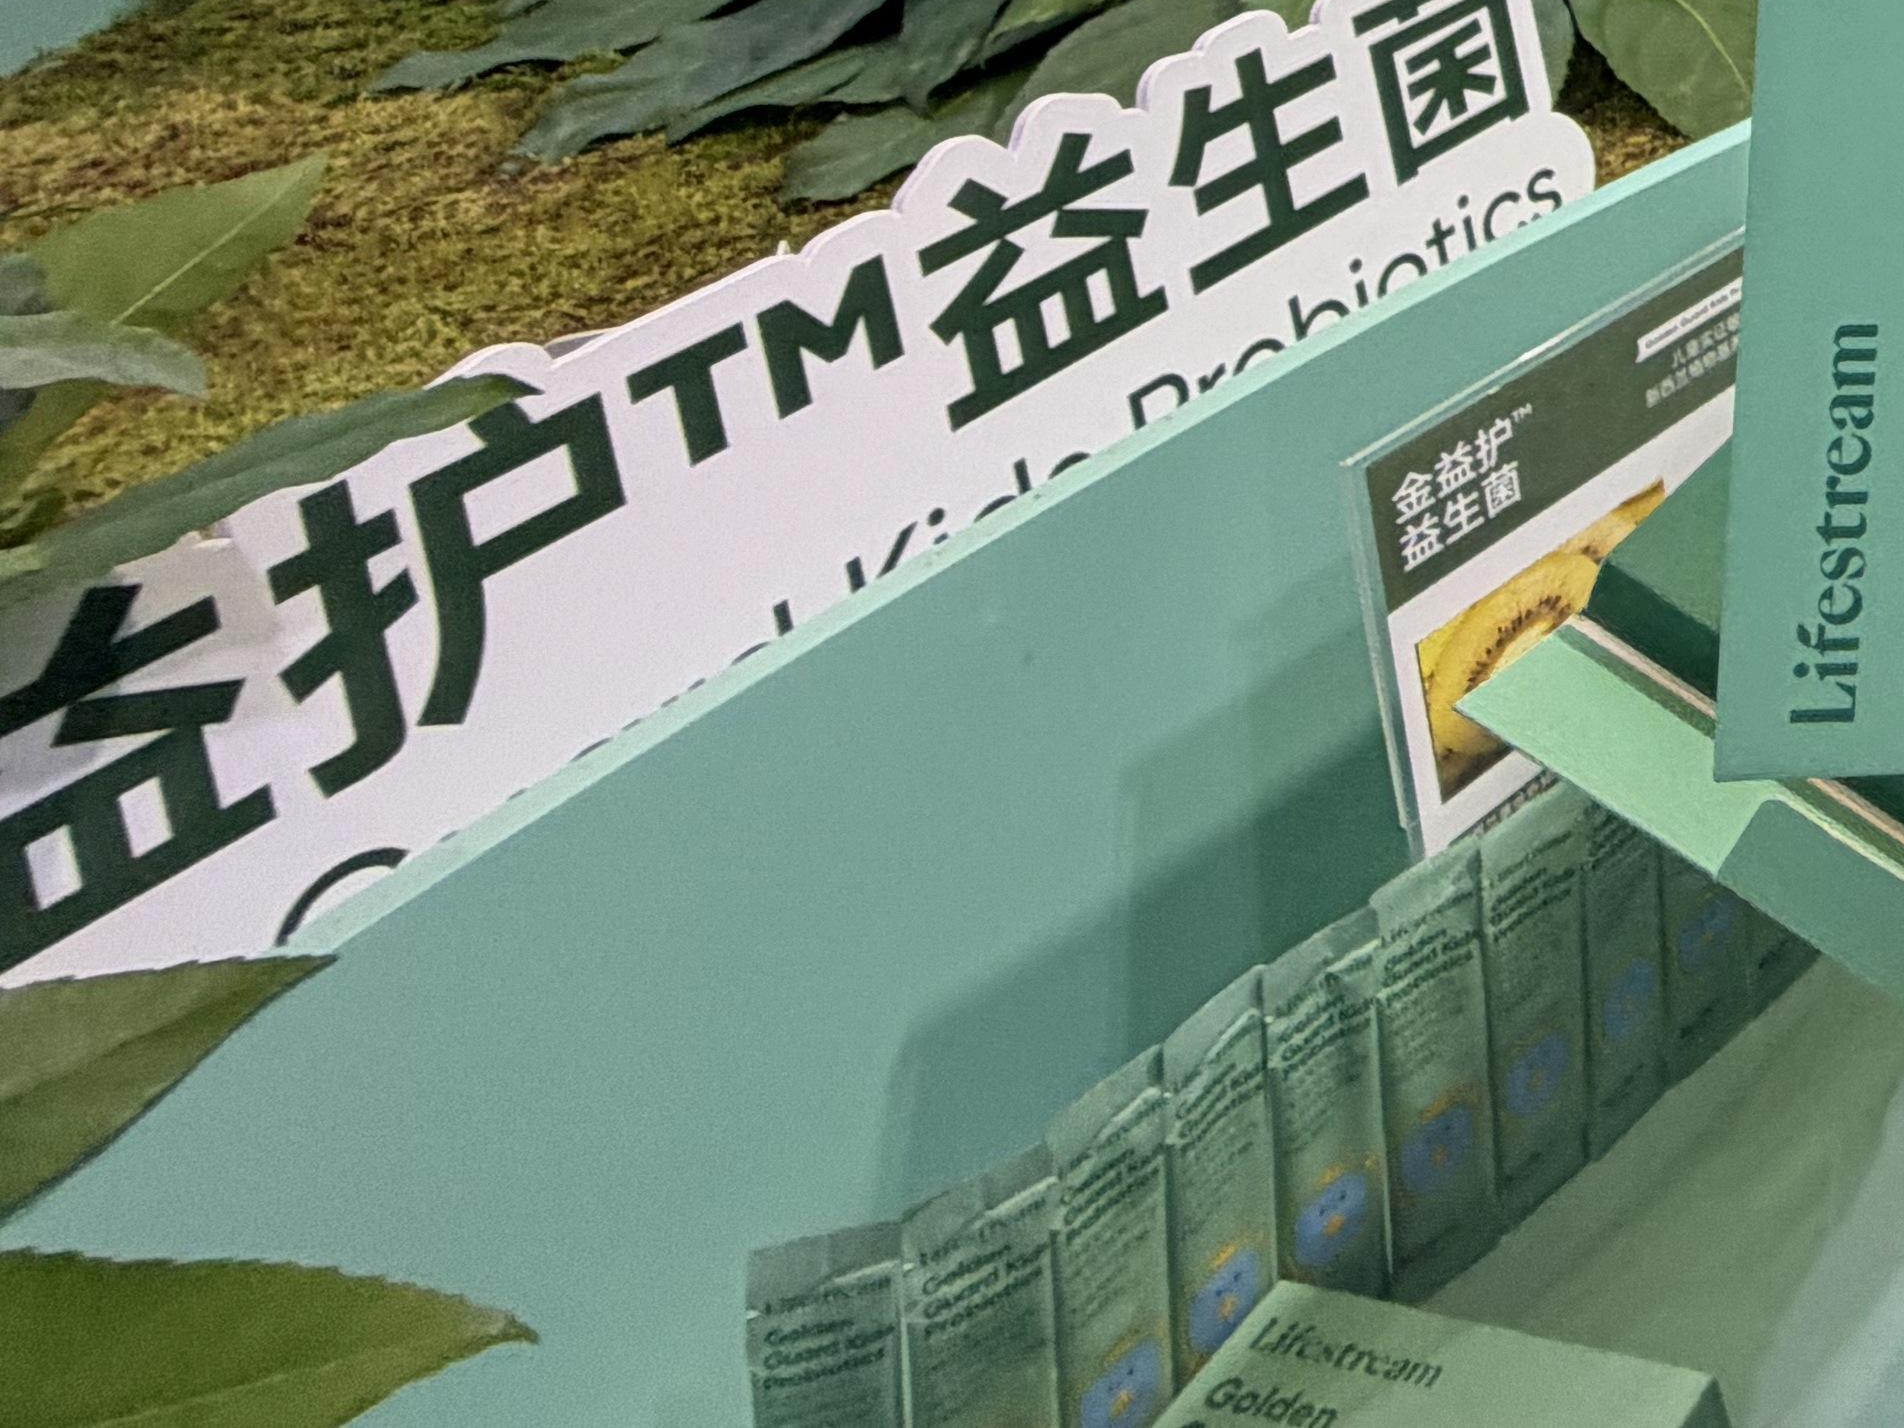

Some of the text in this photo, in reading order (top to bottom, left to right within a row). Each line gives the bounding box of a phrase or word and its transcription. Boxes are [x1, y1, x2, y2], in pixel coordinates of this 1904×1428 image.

[1399, 460, 1522, 573] 益生菌
[1789, 323, 1879, 724] Lifestream
